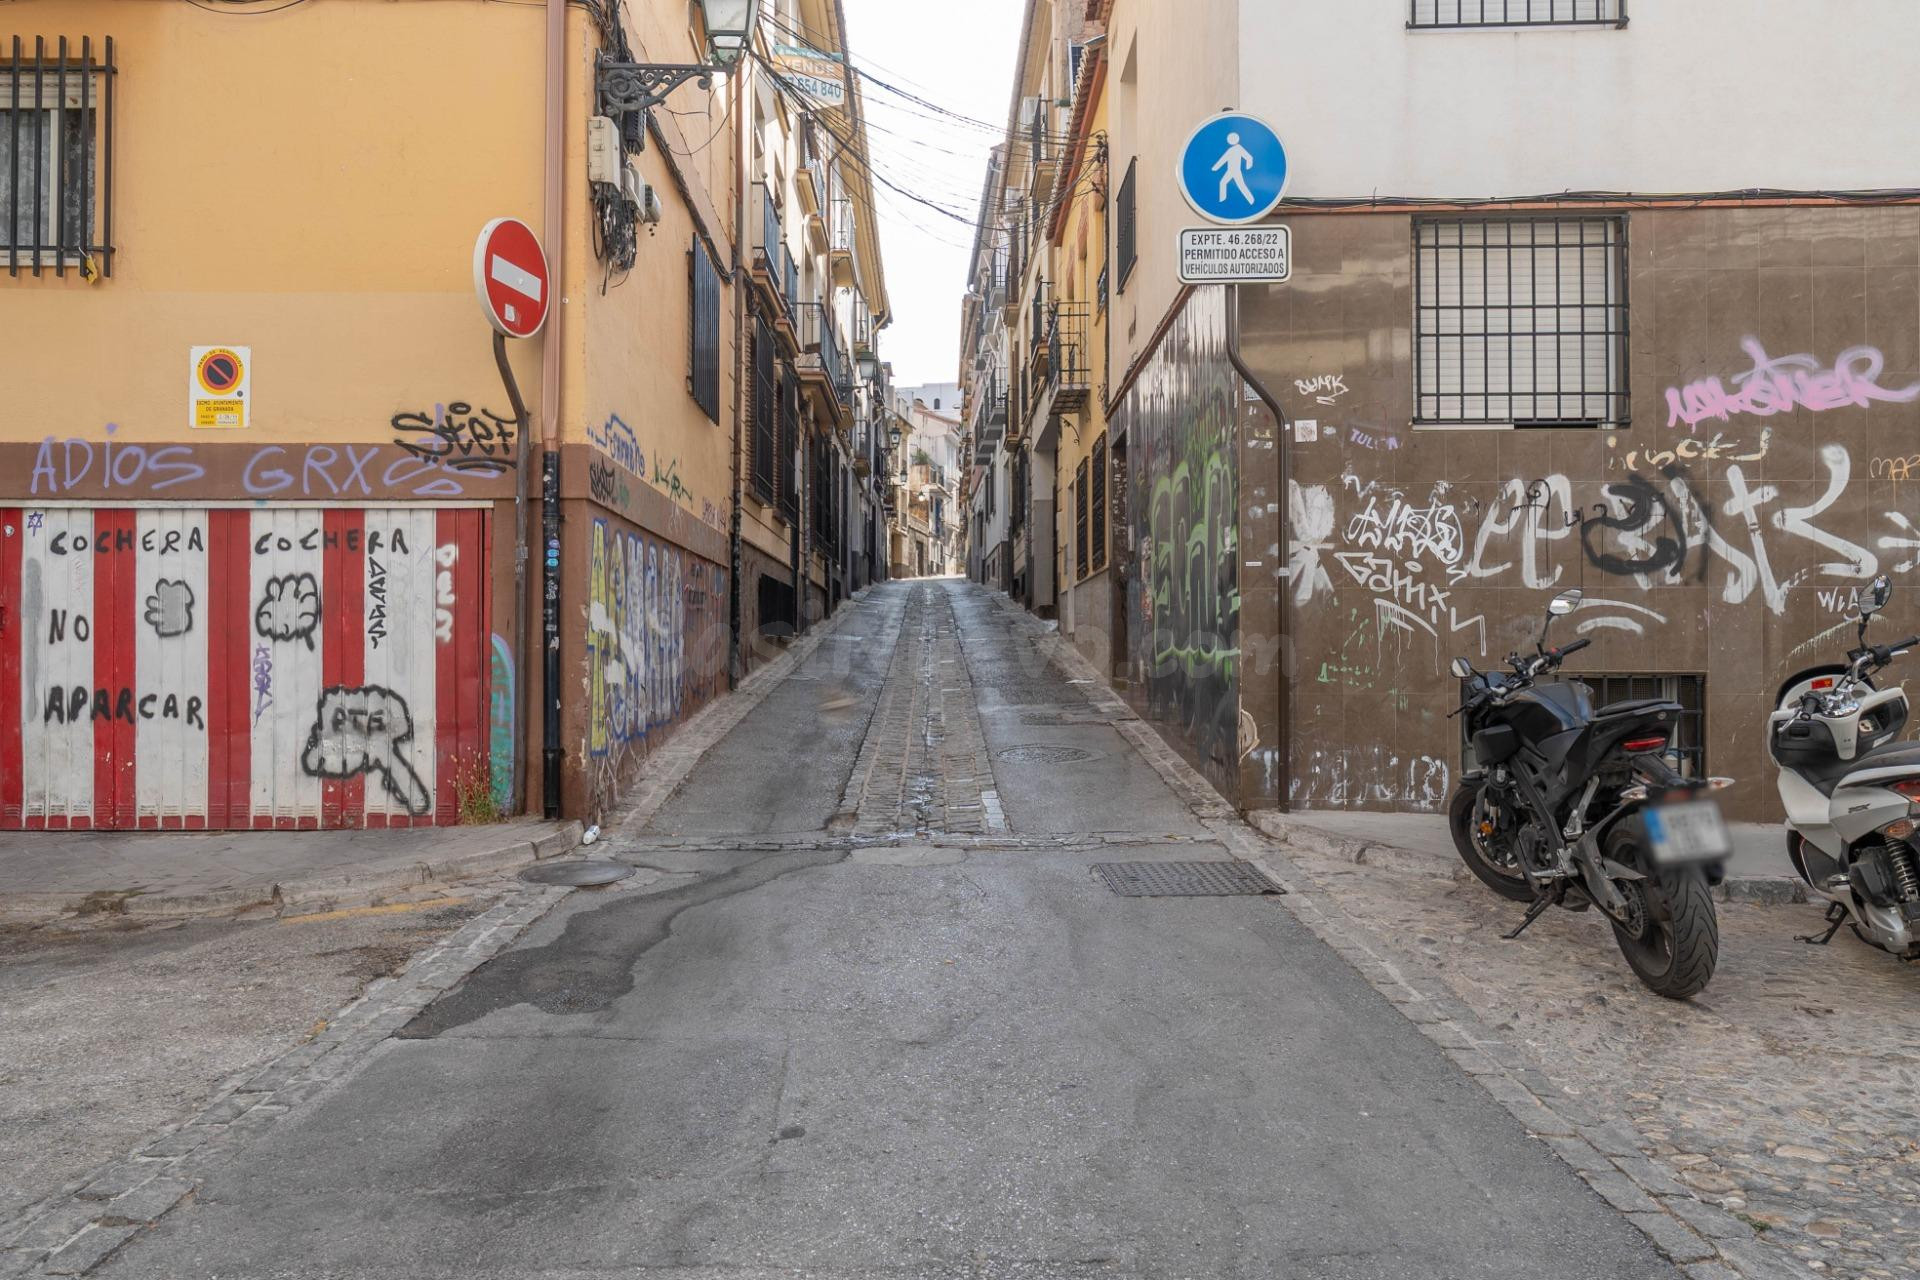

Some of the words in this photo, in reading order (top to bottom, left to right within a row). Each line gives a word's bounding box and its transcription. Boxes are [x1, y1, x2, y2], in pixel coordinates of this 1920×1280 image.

[821, 80, 842, 99] 840
[1191, 234, 1226, 246] EXPTE.
[1228, 233, 1278, 246] 46.268/22
[1185, 248, 1237, 260] PERMITIDO
[1240, 248, 1276, 259] ACCESO
[1278, 248, 1284, 259] A
[1185, 261, 1228, 275] VEHÍCULOS
[1230, 262, 1284, 274] AUTORIZADOS
[243, 446, 379, 495] GRX
[50, 527, 204, 555] COCHERA
[254, 528, 409, 554] COCHERA
[49, 609, 90, 645] NO
[44, 685, 204, 731] APARCAR
